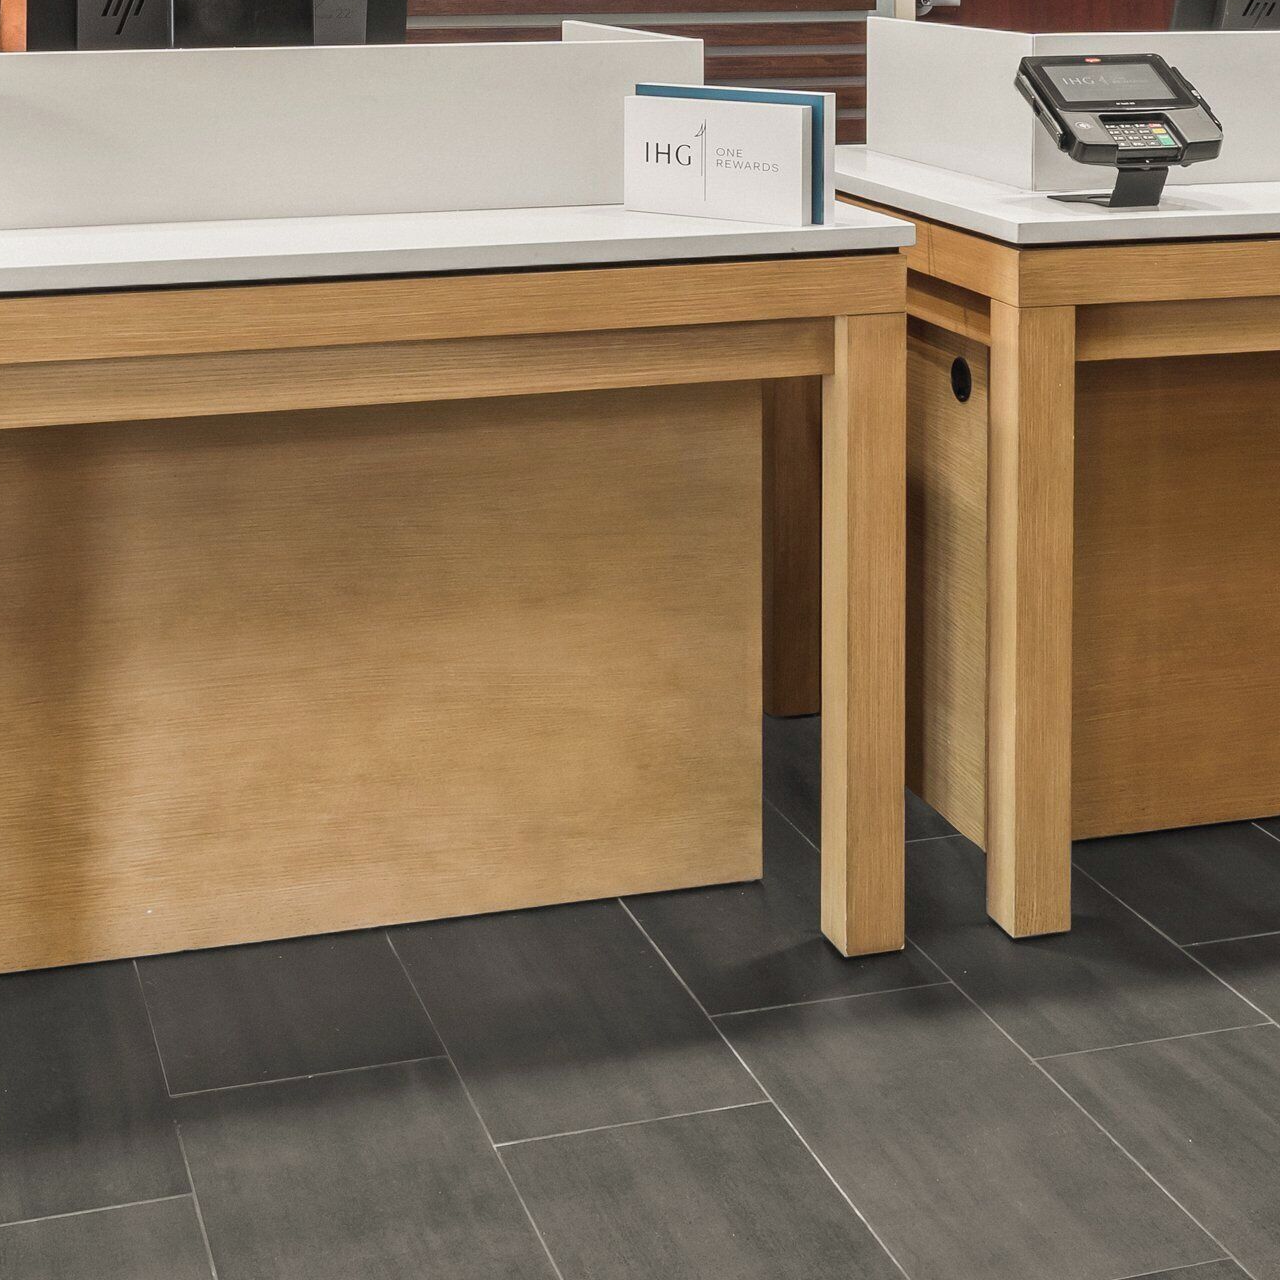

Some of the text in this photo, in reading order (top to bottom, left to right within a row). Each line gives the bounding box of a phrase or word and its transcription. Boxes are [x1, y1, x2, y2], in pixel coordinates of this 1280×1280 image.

[645, 141, 692, 166] IHG
[715, 147, 743, 158] ONE
[716, 158, 780, 173] REWARDS
